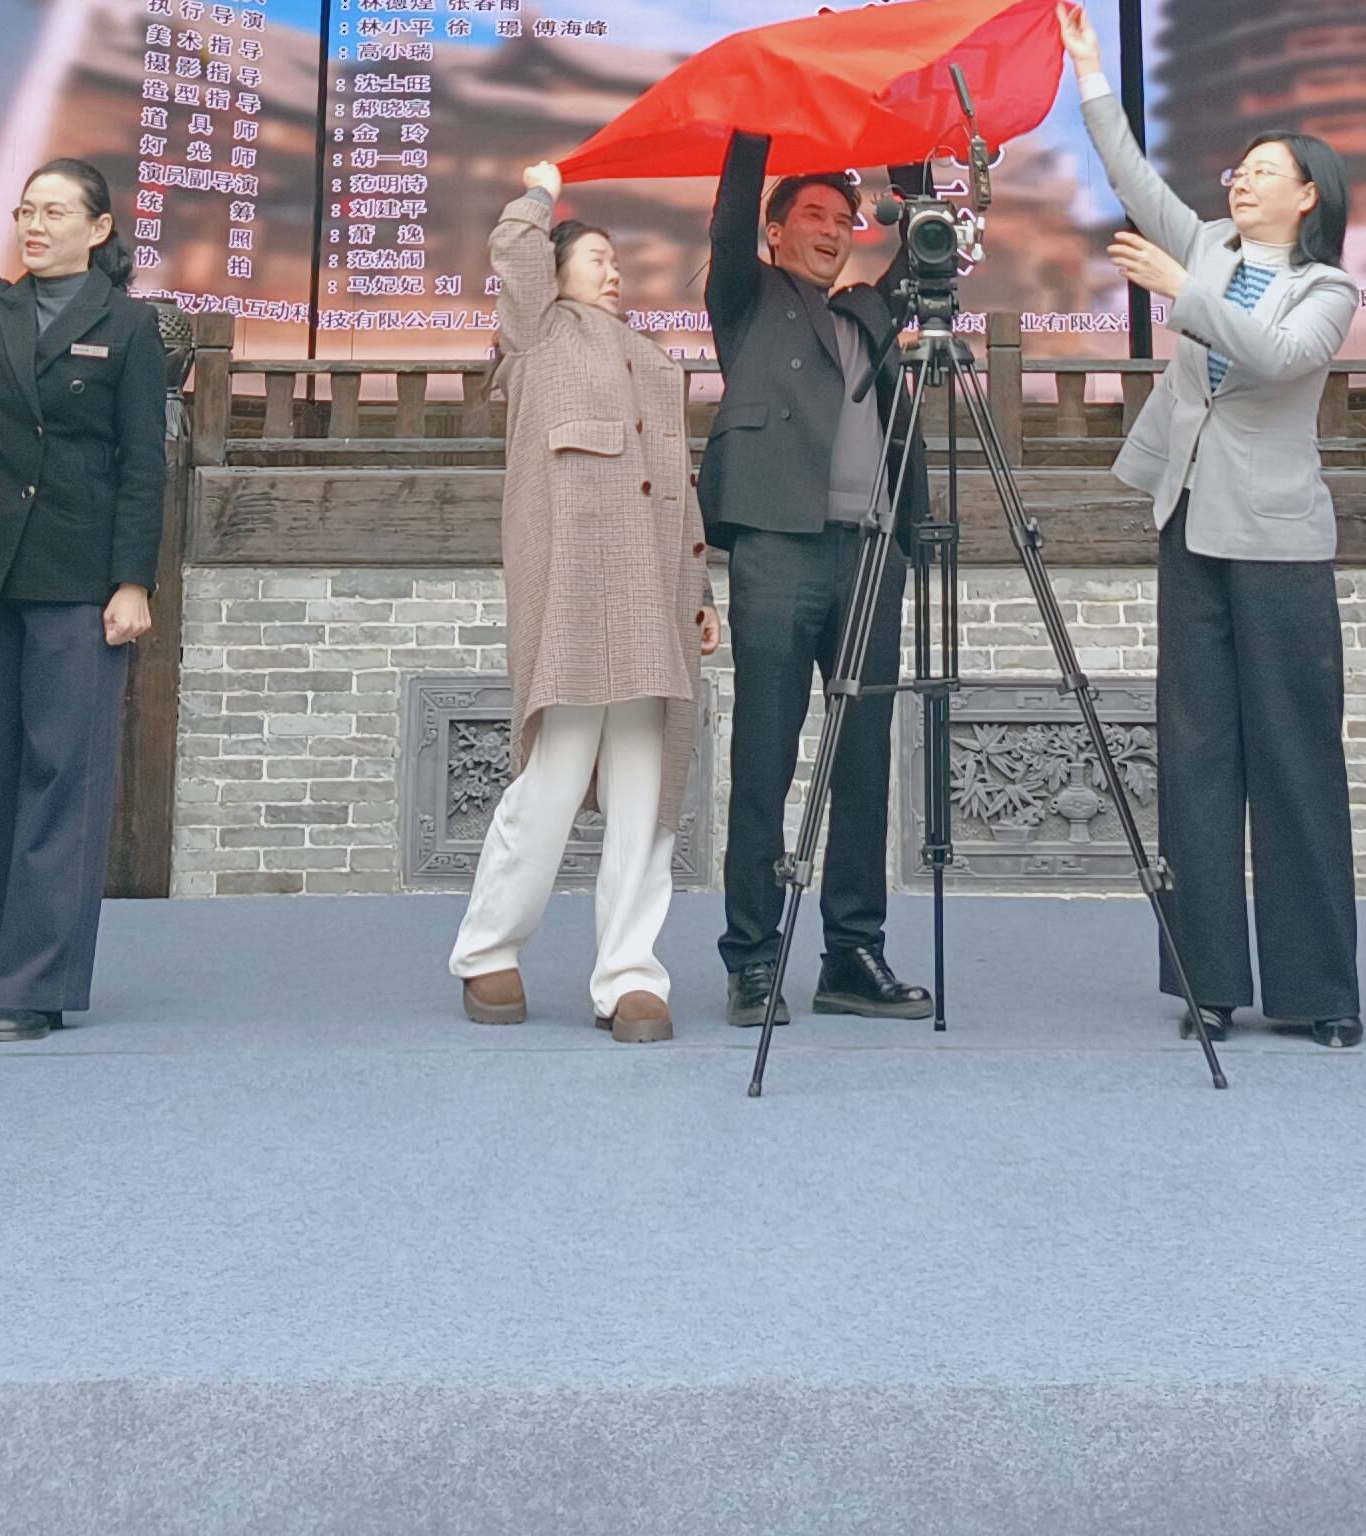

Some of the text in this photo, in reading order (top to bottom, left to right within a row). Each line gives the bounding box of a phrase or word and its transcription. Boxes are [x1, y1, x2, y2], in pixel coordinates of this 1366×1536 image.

[146, 23, 262, 61] 美术指导
[534, 19, 608, 37] 傅海峰
[144, 51, 262, 88] 摄影指导
[142, 78, 261, 115] 造型指导
[141, 106, 258, 141] 道具师
[140, 134, 257, 169] 灯光师
[138, 161, 258, 198] 演员副导演
